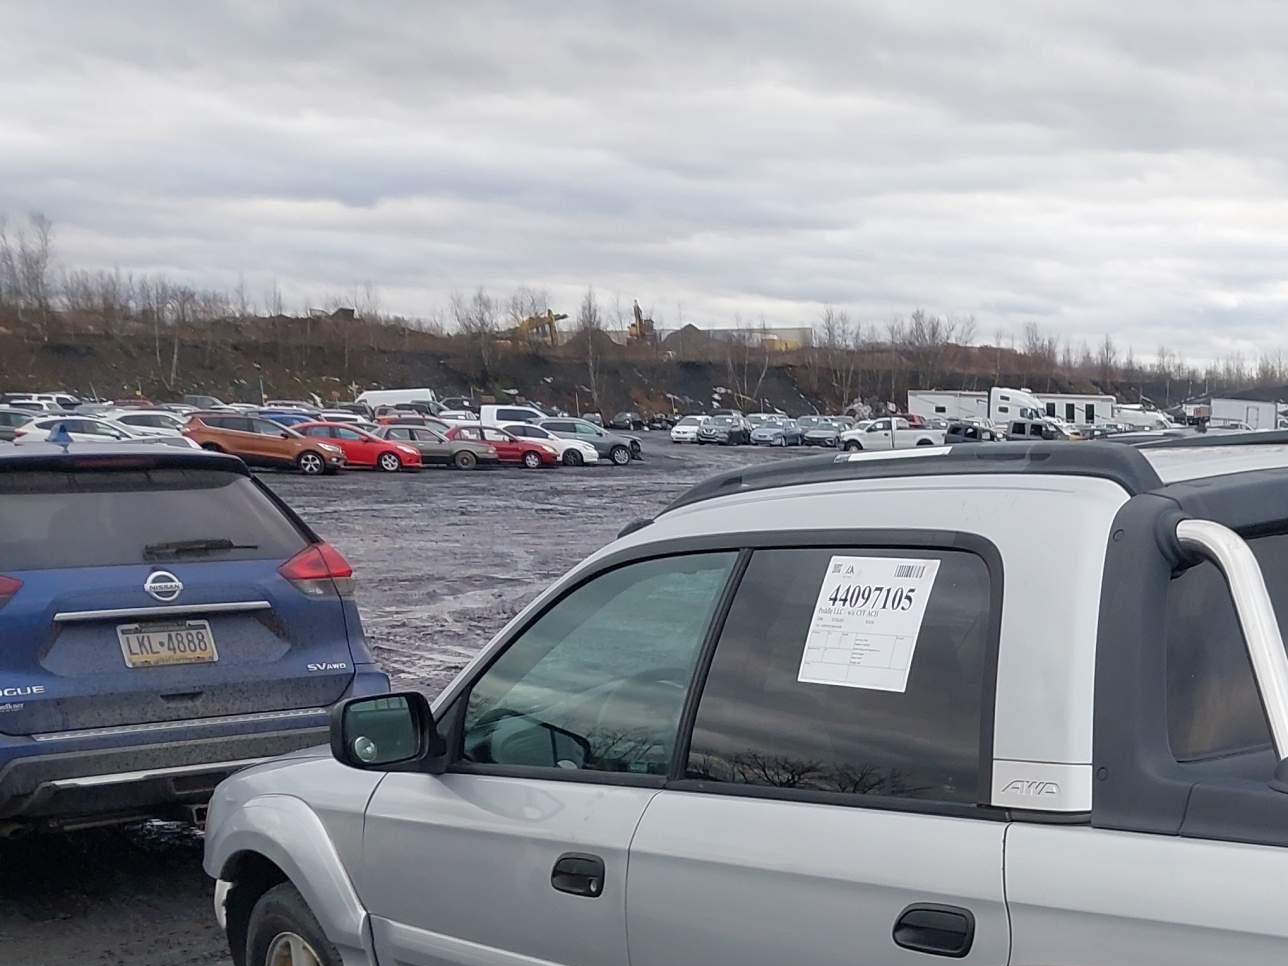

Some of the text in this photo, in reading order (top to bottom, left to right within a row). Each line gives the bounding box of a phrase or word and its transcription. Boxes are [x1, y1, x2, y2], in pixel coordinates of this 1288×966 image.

[149, 584, 180, 592] NISSAN
[828, 584, 916, 611] 44097105
[0, 685, 48, 697] GUE
[1001, 779, 1061, 796] AWD
